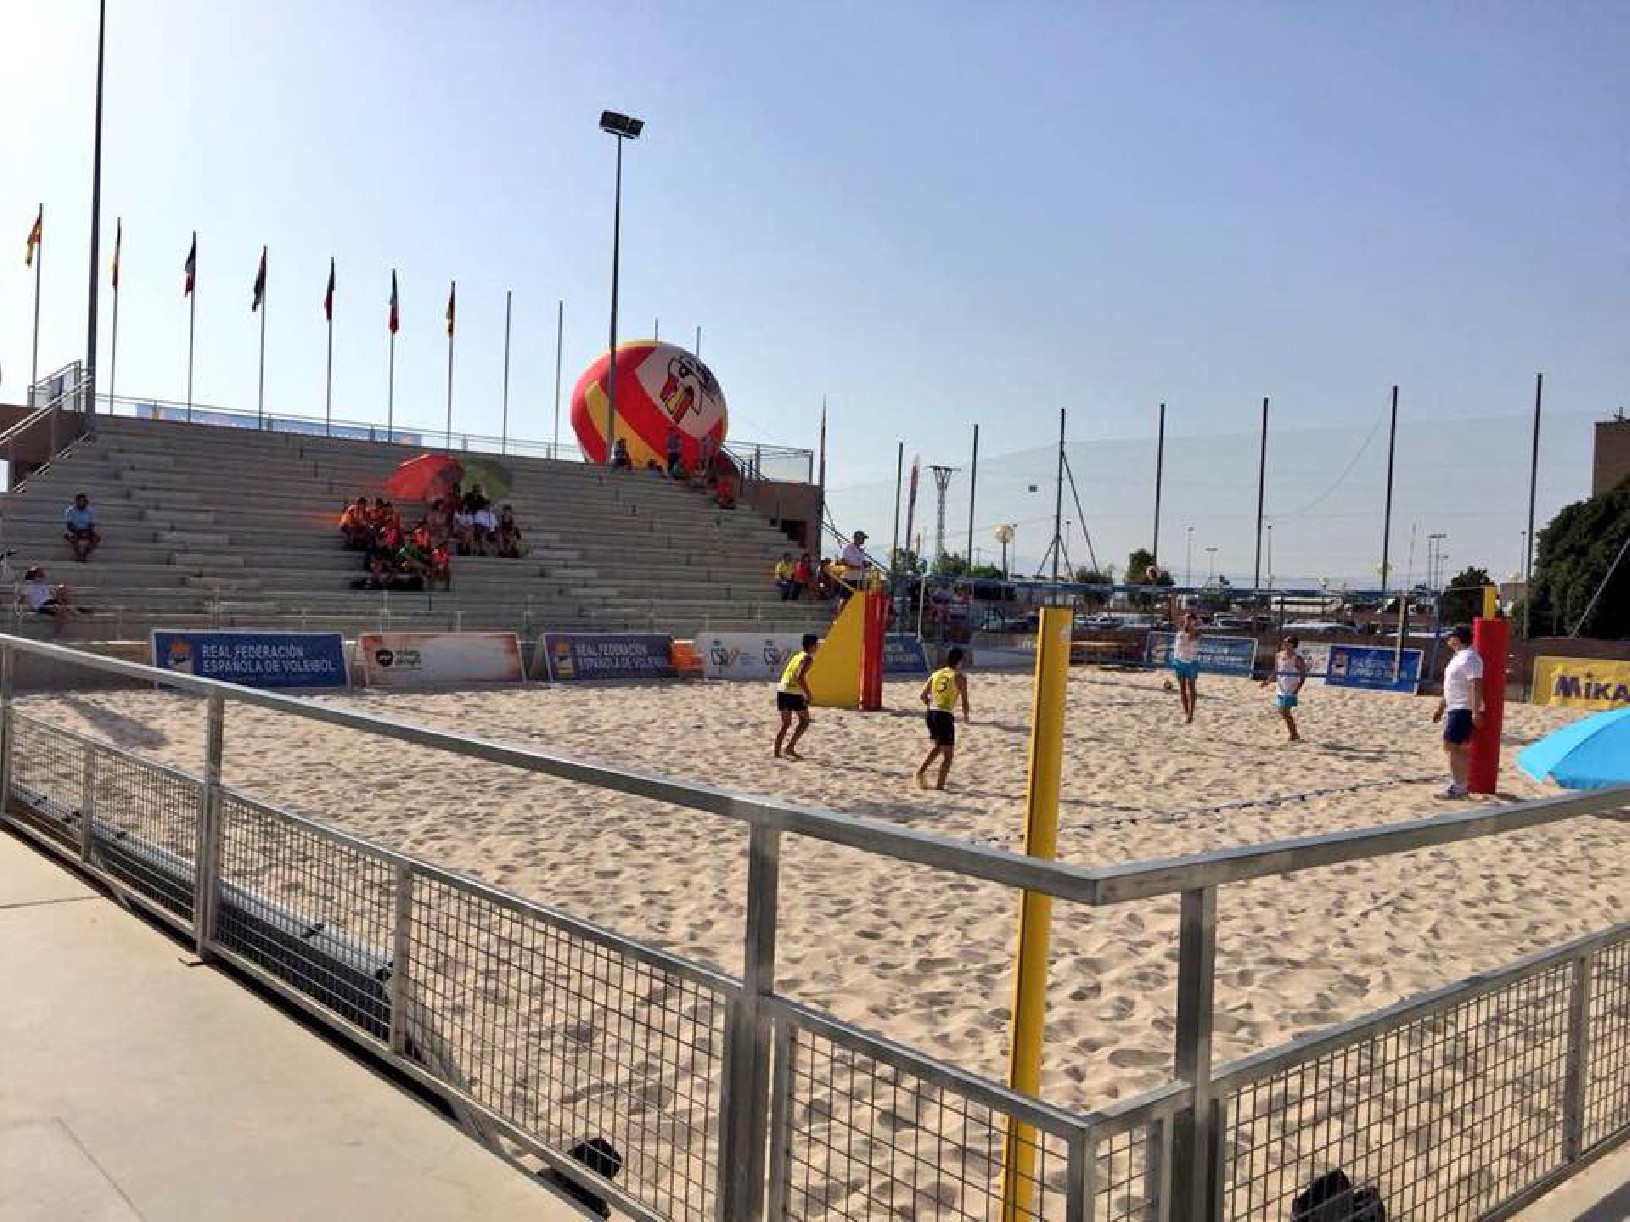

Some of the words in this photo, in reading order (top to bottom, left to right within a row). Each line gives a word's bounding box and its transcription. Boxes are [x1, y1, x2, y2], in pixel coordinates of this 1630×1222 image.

[202, 644, 232, 658] REAL
[202, 658, 263, 673] ESPAÑOLA
[265, 659, 281, 673] DE
[282, 659, 337, 673] VOLEIBOL
[936, 676, 950, 694] 3
